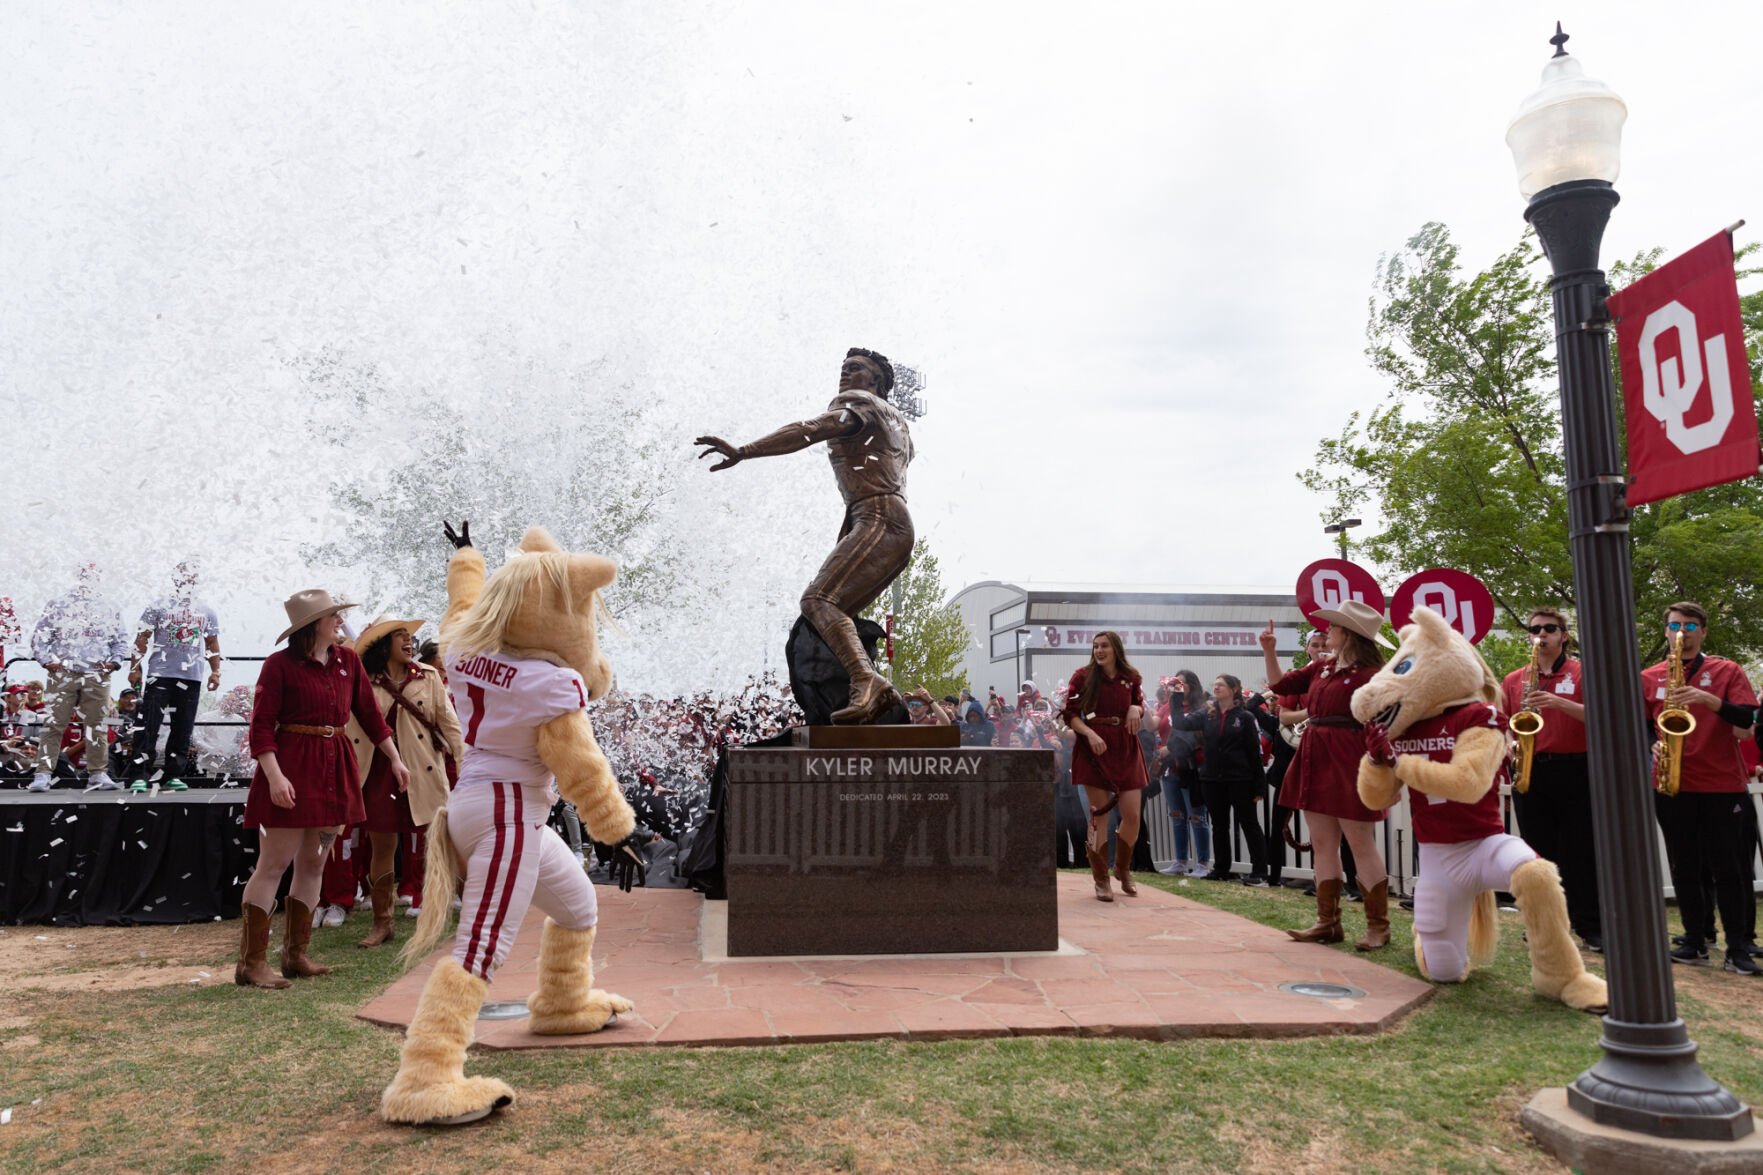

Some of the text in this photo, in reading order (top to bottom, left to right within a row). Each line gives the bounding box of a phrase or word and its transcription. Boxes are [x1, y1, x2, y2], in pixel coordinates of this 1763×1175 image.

[1638, 300, 1734, 455] OU
[1067, 630, 1129, 645] EVET
[1133, 631, 1200, 645] TRAINING
[1204, 631, 1257, 646] CENTER
[572, 679, 586, 708] 1
[464, 682, 485, 747] 1
[1487, 705, 1498, 726] 1
[1394, 736, 1456, 753] SOONERS
[806, 756, 982, 776] KYLER MURRAY
[839, 793, 883, 801] DEDICATED
[887, 793, 908, 801] APRIL
[928, 793, 949, 801] 2023
